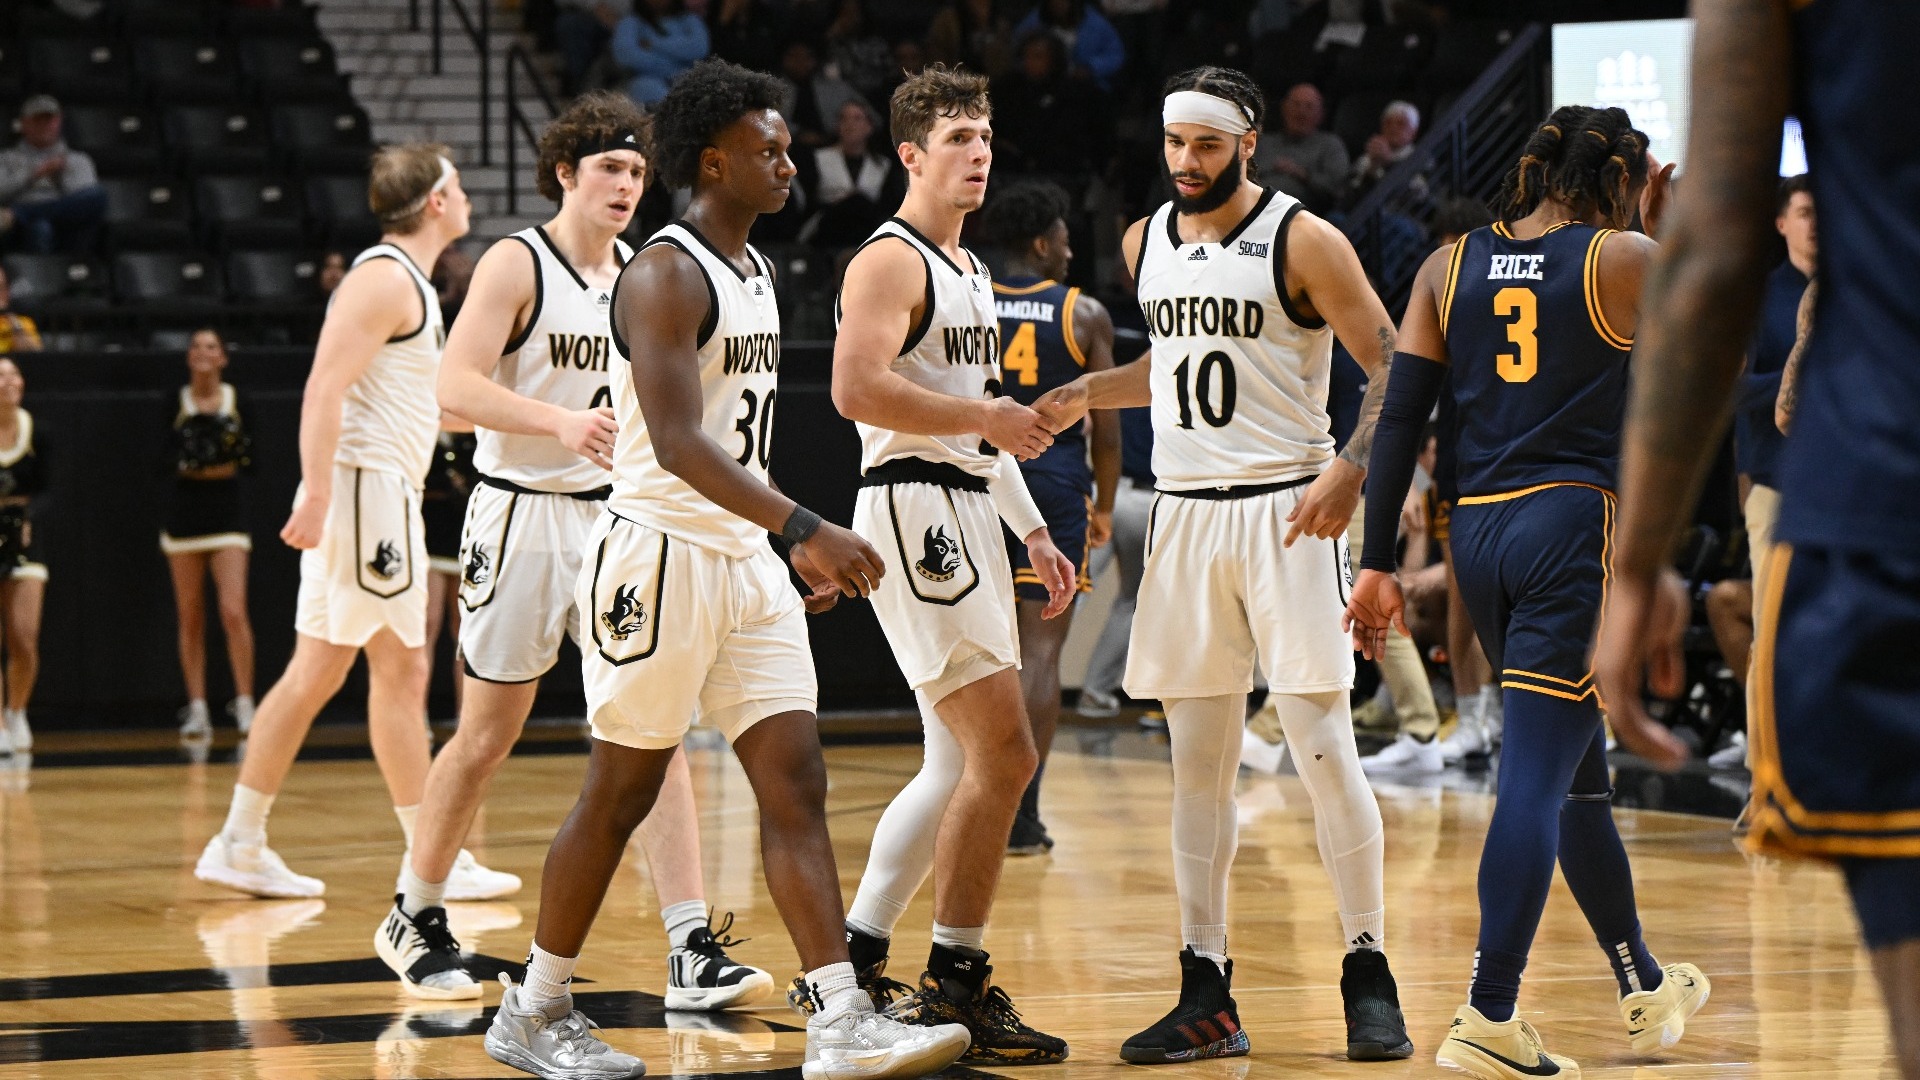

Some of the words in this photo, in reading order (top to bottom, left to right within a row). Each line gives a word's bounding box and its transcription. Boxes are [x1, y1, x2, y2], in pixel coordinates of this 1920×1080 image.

[1187, 253, 1208, 261] adidas
[1238, 240, 1269, 258] SOCON
[1487, 254, 1545, 281] RICE
[1142, 296, 1264, 339] WOFFORD
[1493, 287, 1538, 383] 3
[998, 321, 1039, 386] 4
[1172, 350, 1237, 430] 10
[735, 388, 776, 470] 30
